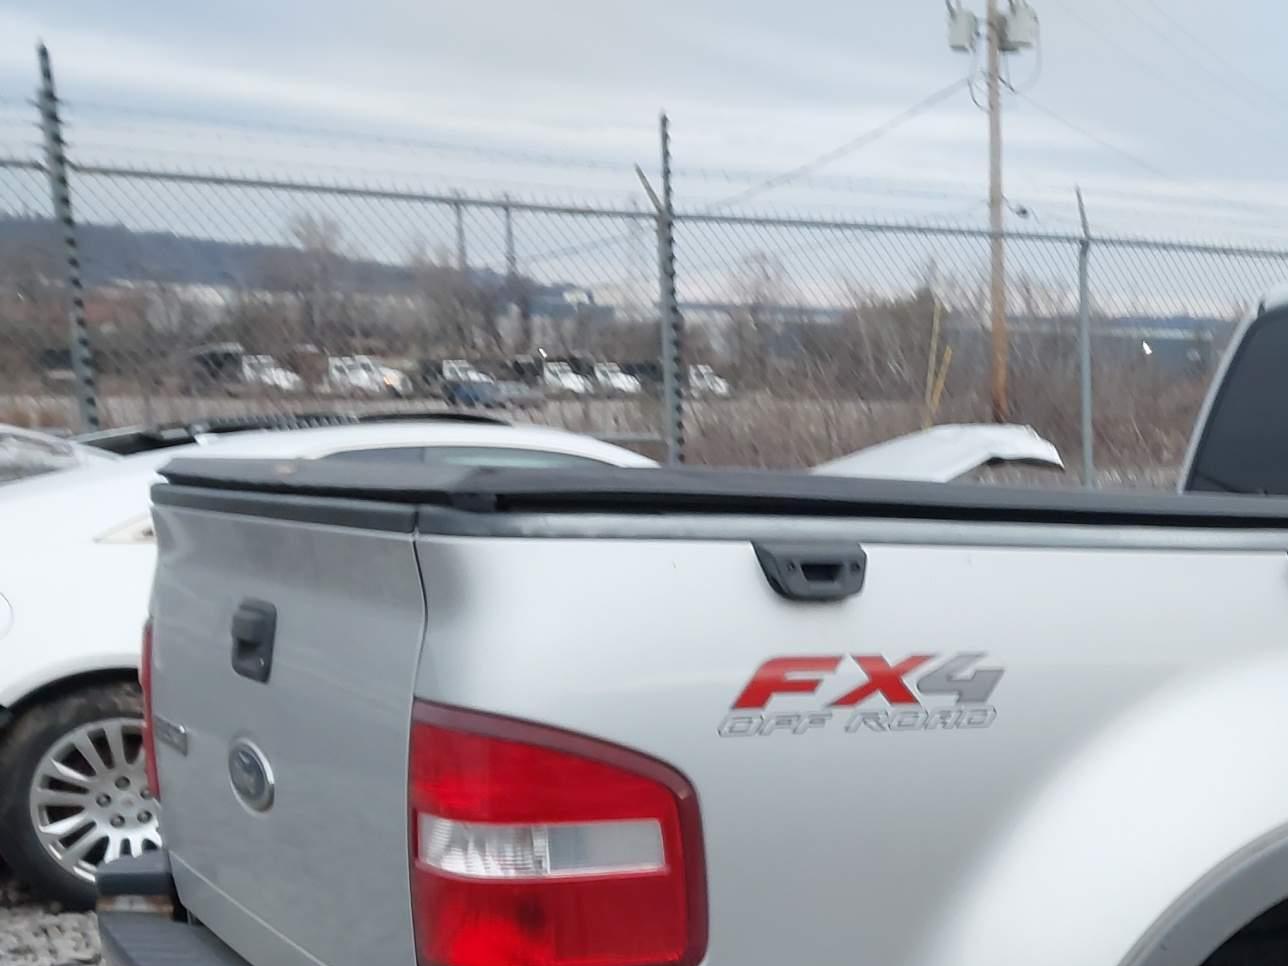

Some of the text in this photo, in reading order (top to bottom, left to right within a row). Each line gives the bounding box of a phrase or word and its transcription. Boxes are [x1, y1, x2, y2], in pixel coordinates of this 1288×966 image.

[731, 653, 1004, 709] FX4
[717, 705, 998, 737] OFF ROAD
